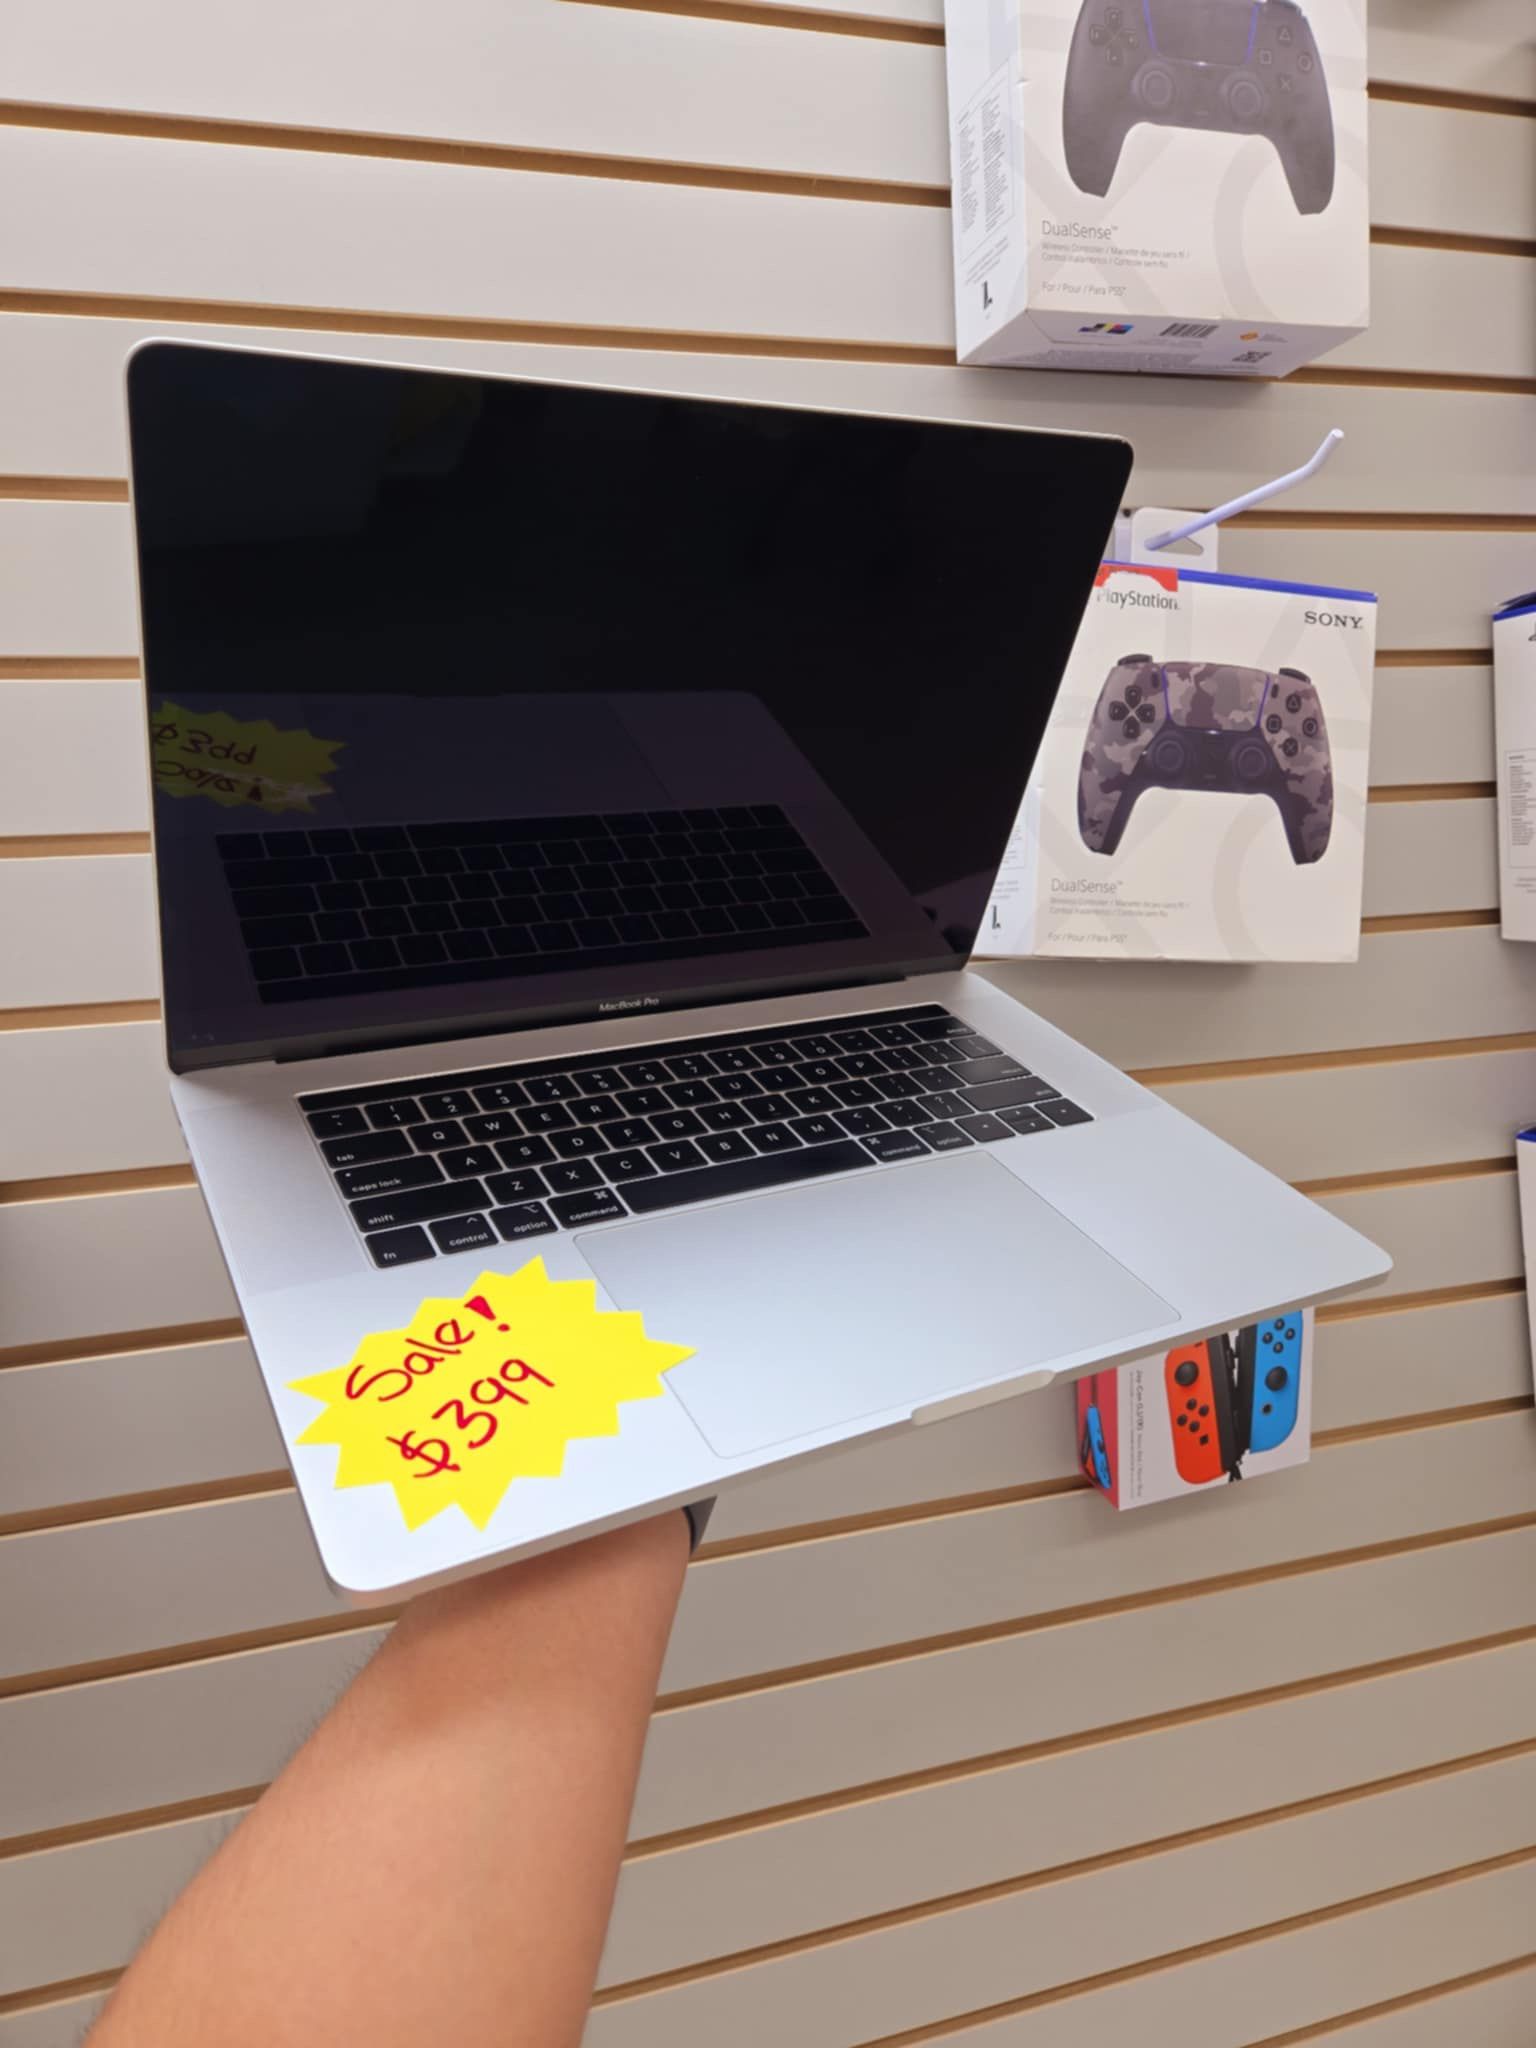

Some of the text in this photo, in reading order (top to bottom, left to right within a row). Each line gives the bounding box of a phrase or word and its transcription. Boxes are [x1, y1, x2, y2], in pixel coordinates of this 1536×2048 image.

[1304, 611, 1363, 629] SONY
[600, 1000, 641, 1010] MacBook
[336, 1154, 355, 1162] tab
[351, 1178, 401, 1194] caps lock
[368, 1214, 395, 1225] shift
[569, 1205, 619, 1221] command
[513, 1220, 548, 1233] option
[449, 1232, 489, 1246] control
[383, 1252, 397, 1260] fn
[345, 1295, 511, 1402] Sale!
[386, 1359, 555, 1478] $399
